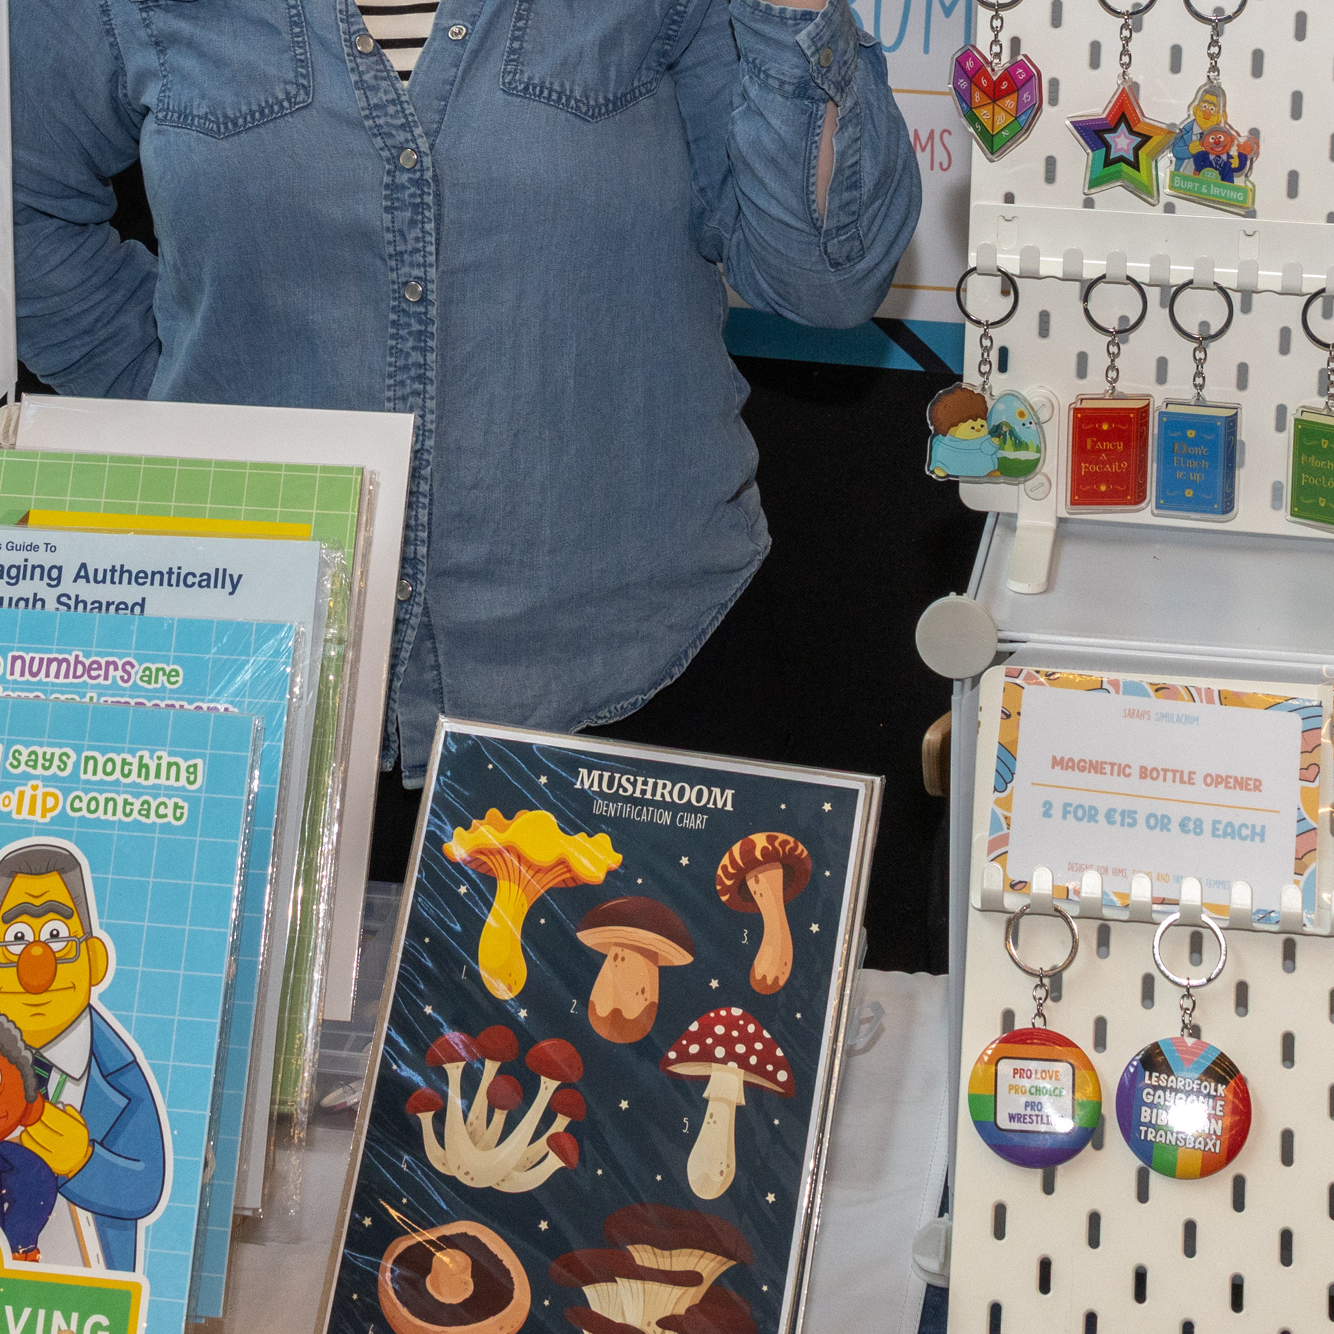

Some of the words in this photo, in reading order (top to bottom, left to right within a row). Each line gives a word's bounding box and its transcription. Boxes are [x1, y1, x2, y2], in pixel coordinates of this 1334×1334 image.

[6, 542, 39, 552] Guide
[42, 542, 57, 553] To
[72, 563, 243, 595] Authentically
[7, 652, 136, 687] numbers
[137, 665, 183, 687] are
[574, 768, 735, 811] MUSHROOM
[1051, 754, 1133, 778] MAGNETIC
[1139, 764, 1197, 787] BOTTLE
[1203, 771, 1263, 794] OPENER
[14, 783, 60, 820] lip
[69, 795, 188, 823] contact
[593, 801, 672, 826] IDENTIFICATION
[676, 813, 708, 830] CHART
